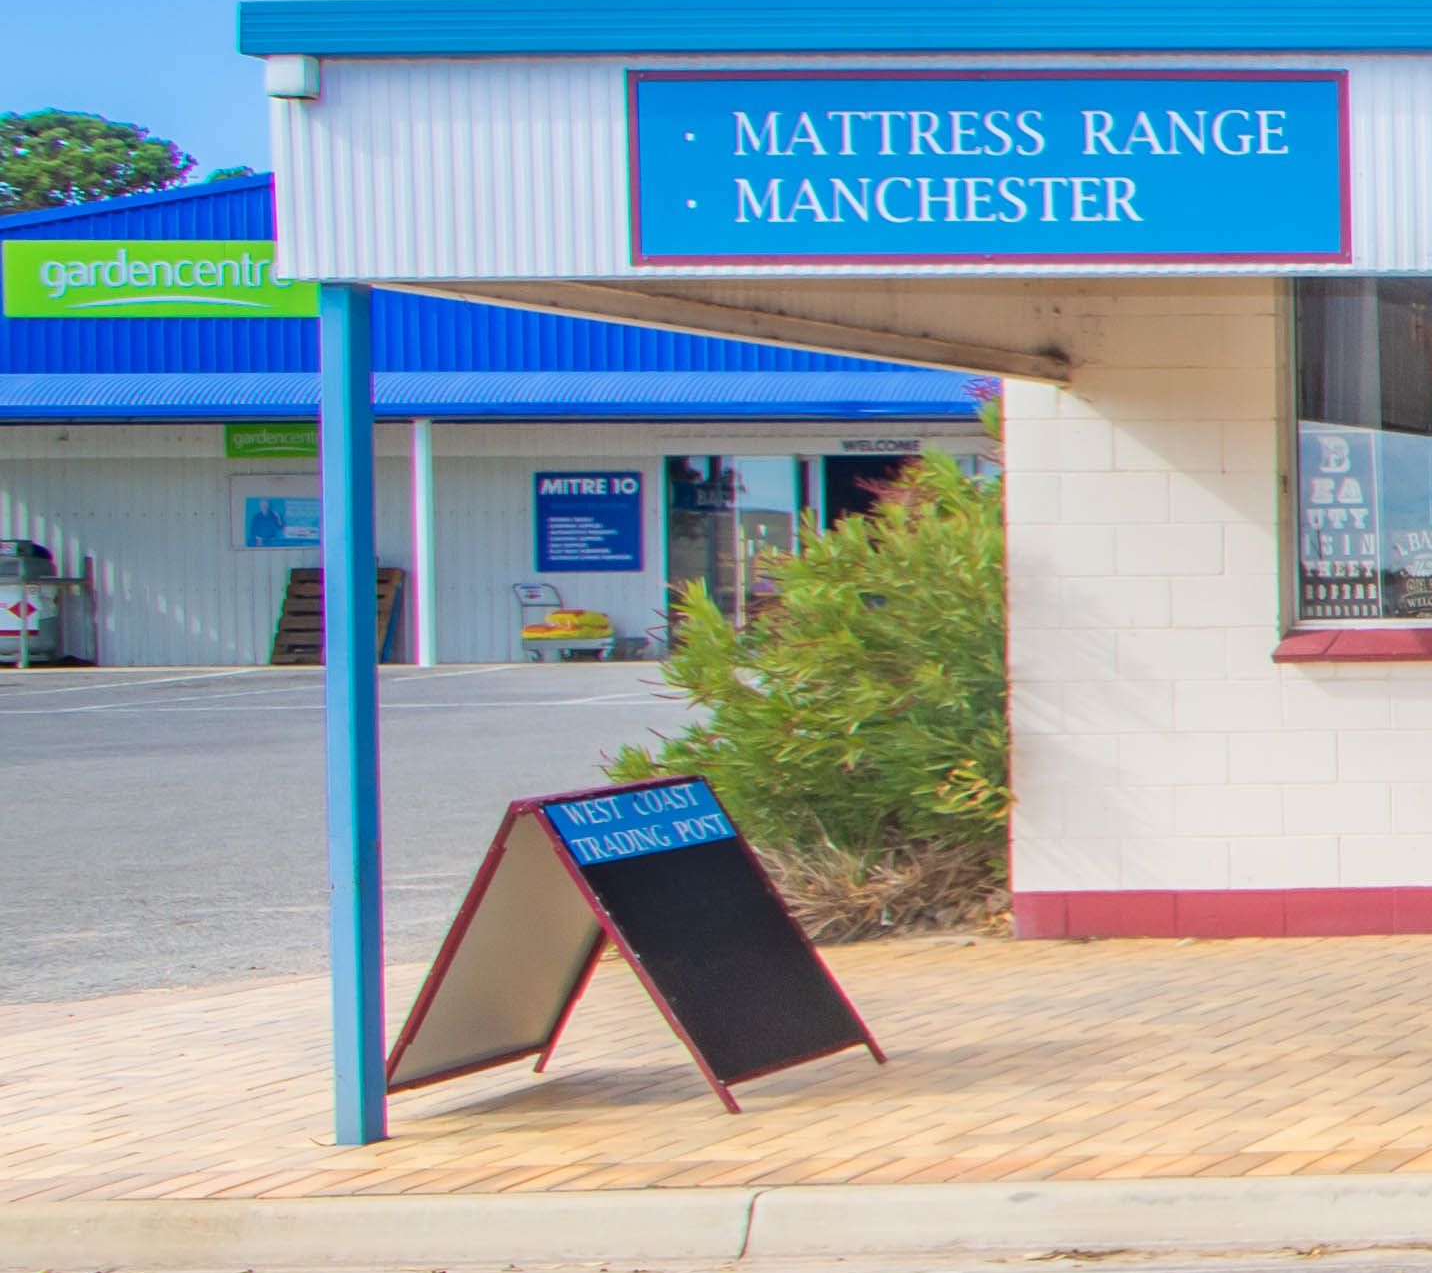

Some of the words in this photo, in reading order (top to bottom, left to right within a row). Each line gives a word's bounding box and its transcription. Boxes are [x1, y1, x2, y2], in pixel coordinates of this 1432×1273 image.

[732, 110, 1044, 157] MATTRESS
[1080, 109, 1289, 155] RANGE
[734, 178, 1143, 223] MANCHESTER
[841, 439, 921, 452] WELCOME
[540, 479, 607, 495] MITRE
[611, 479, 639, 495] 10
[1306, 508, 1369, 529] UTY
[561, 796, 625, 827] WEST
[632, 784, 699, 816] COAST
[570, 825, 673, 862] TRADING
[672, 813, 730, 843] POST
